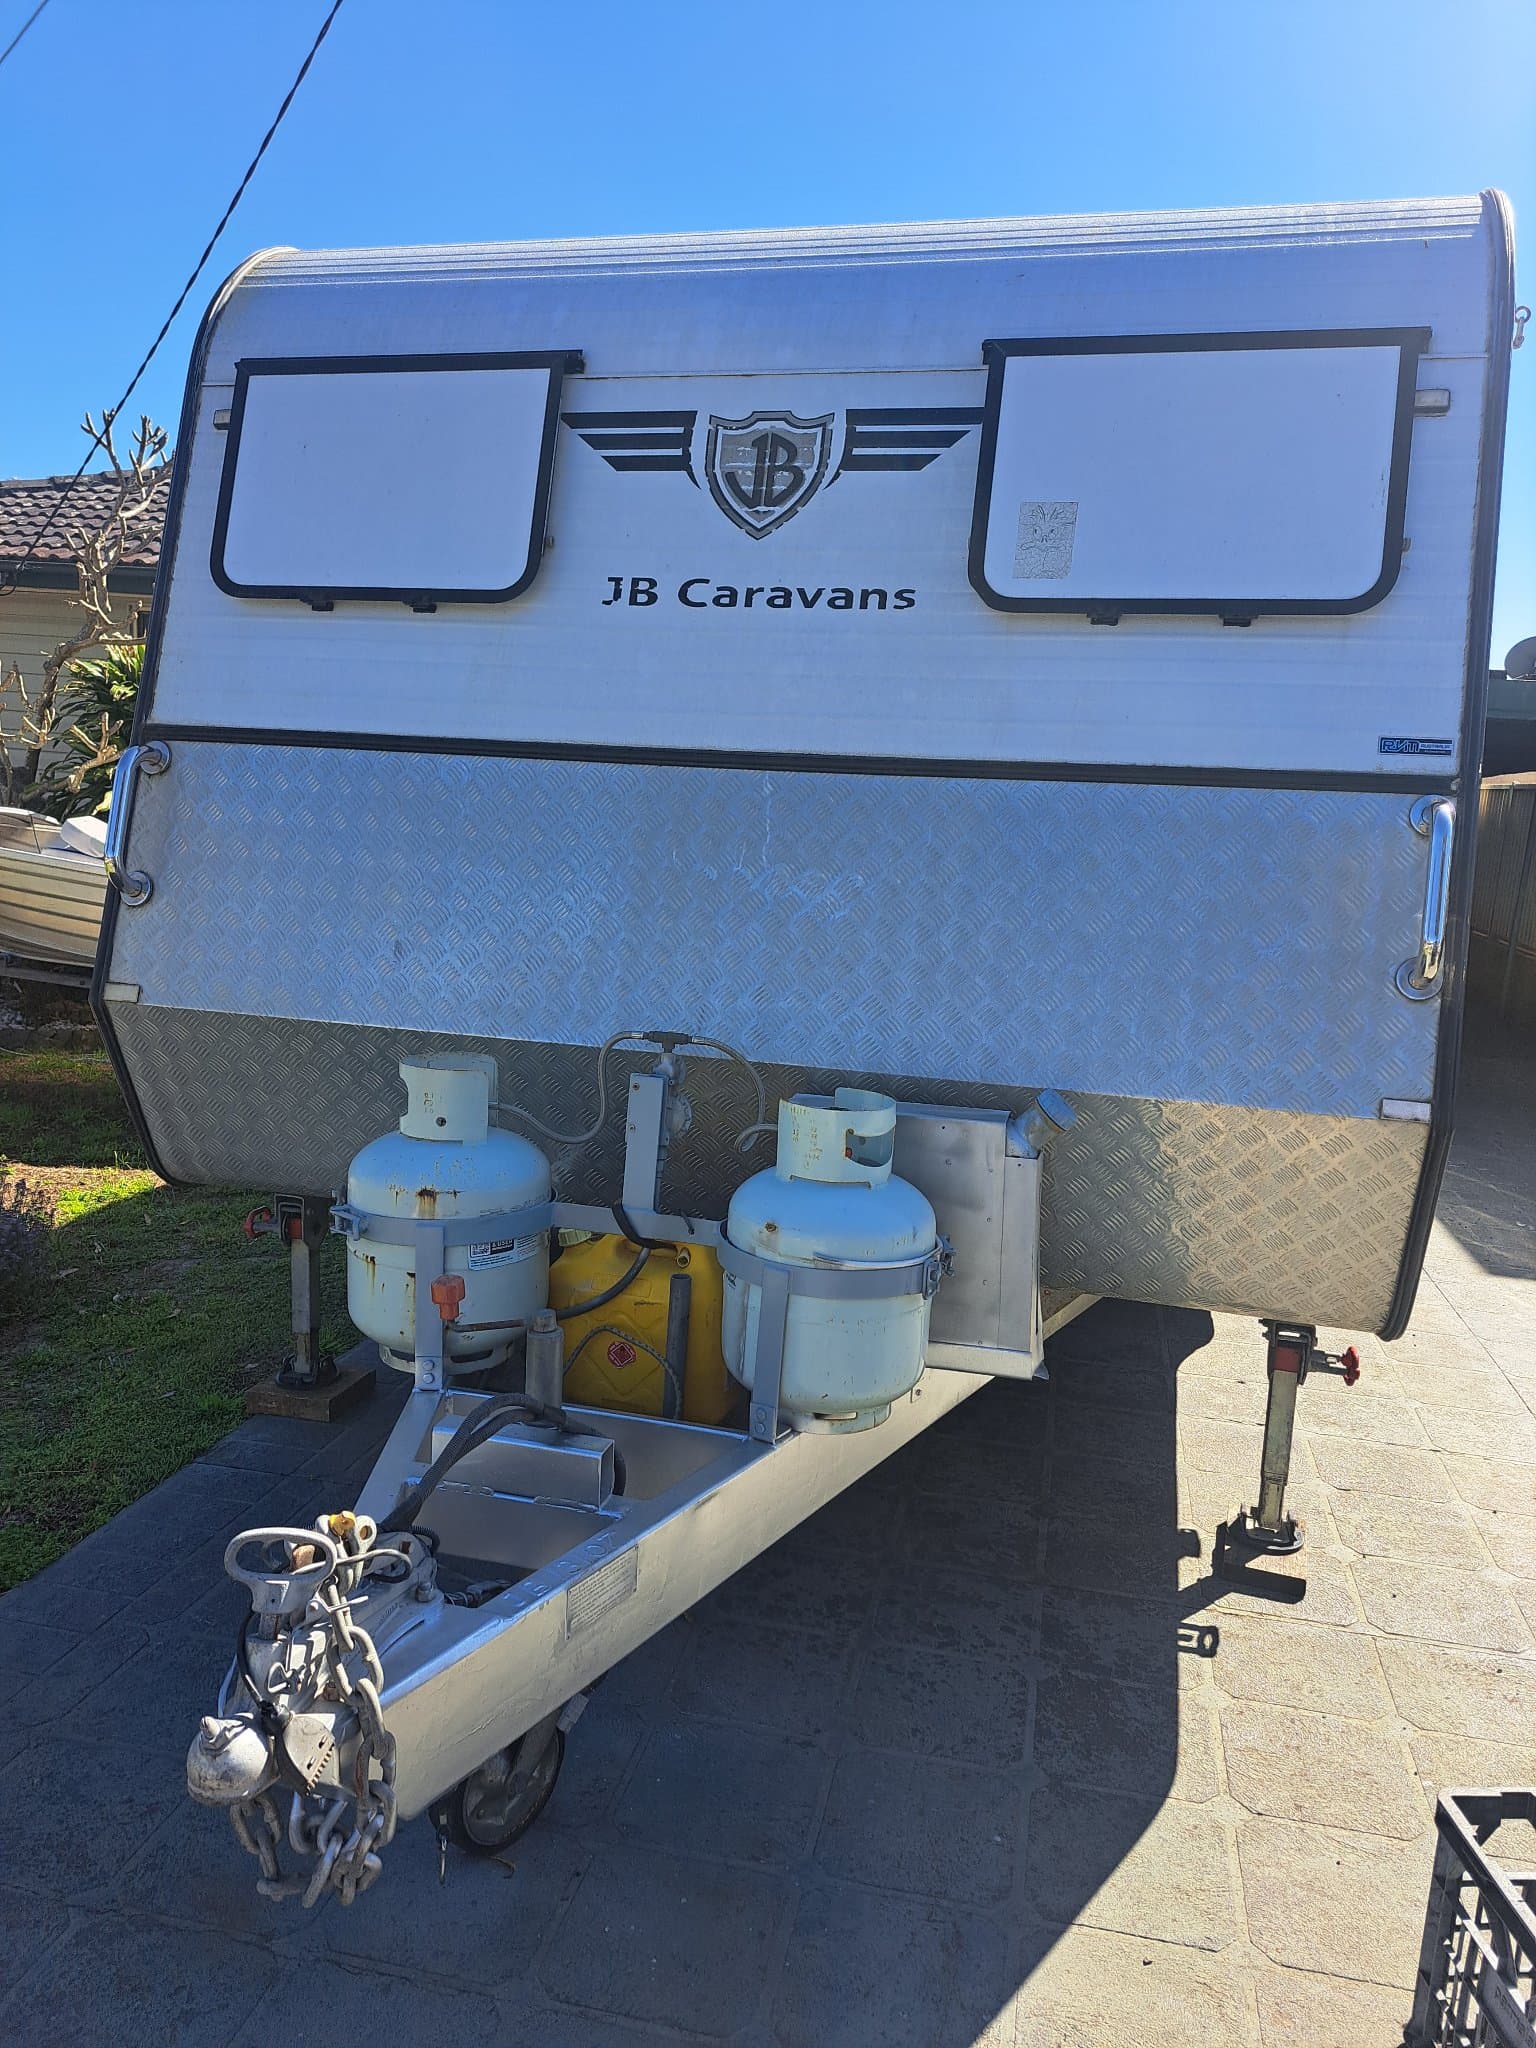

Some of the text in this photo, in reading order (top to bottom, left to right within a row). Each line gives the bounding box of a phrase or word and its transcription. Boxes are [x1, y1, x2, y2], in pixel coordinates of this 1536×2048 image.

[723, 431, 806, 509] JB
[601, 576, 916, 610] JB Caravans
